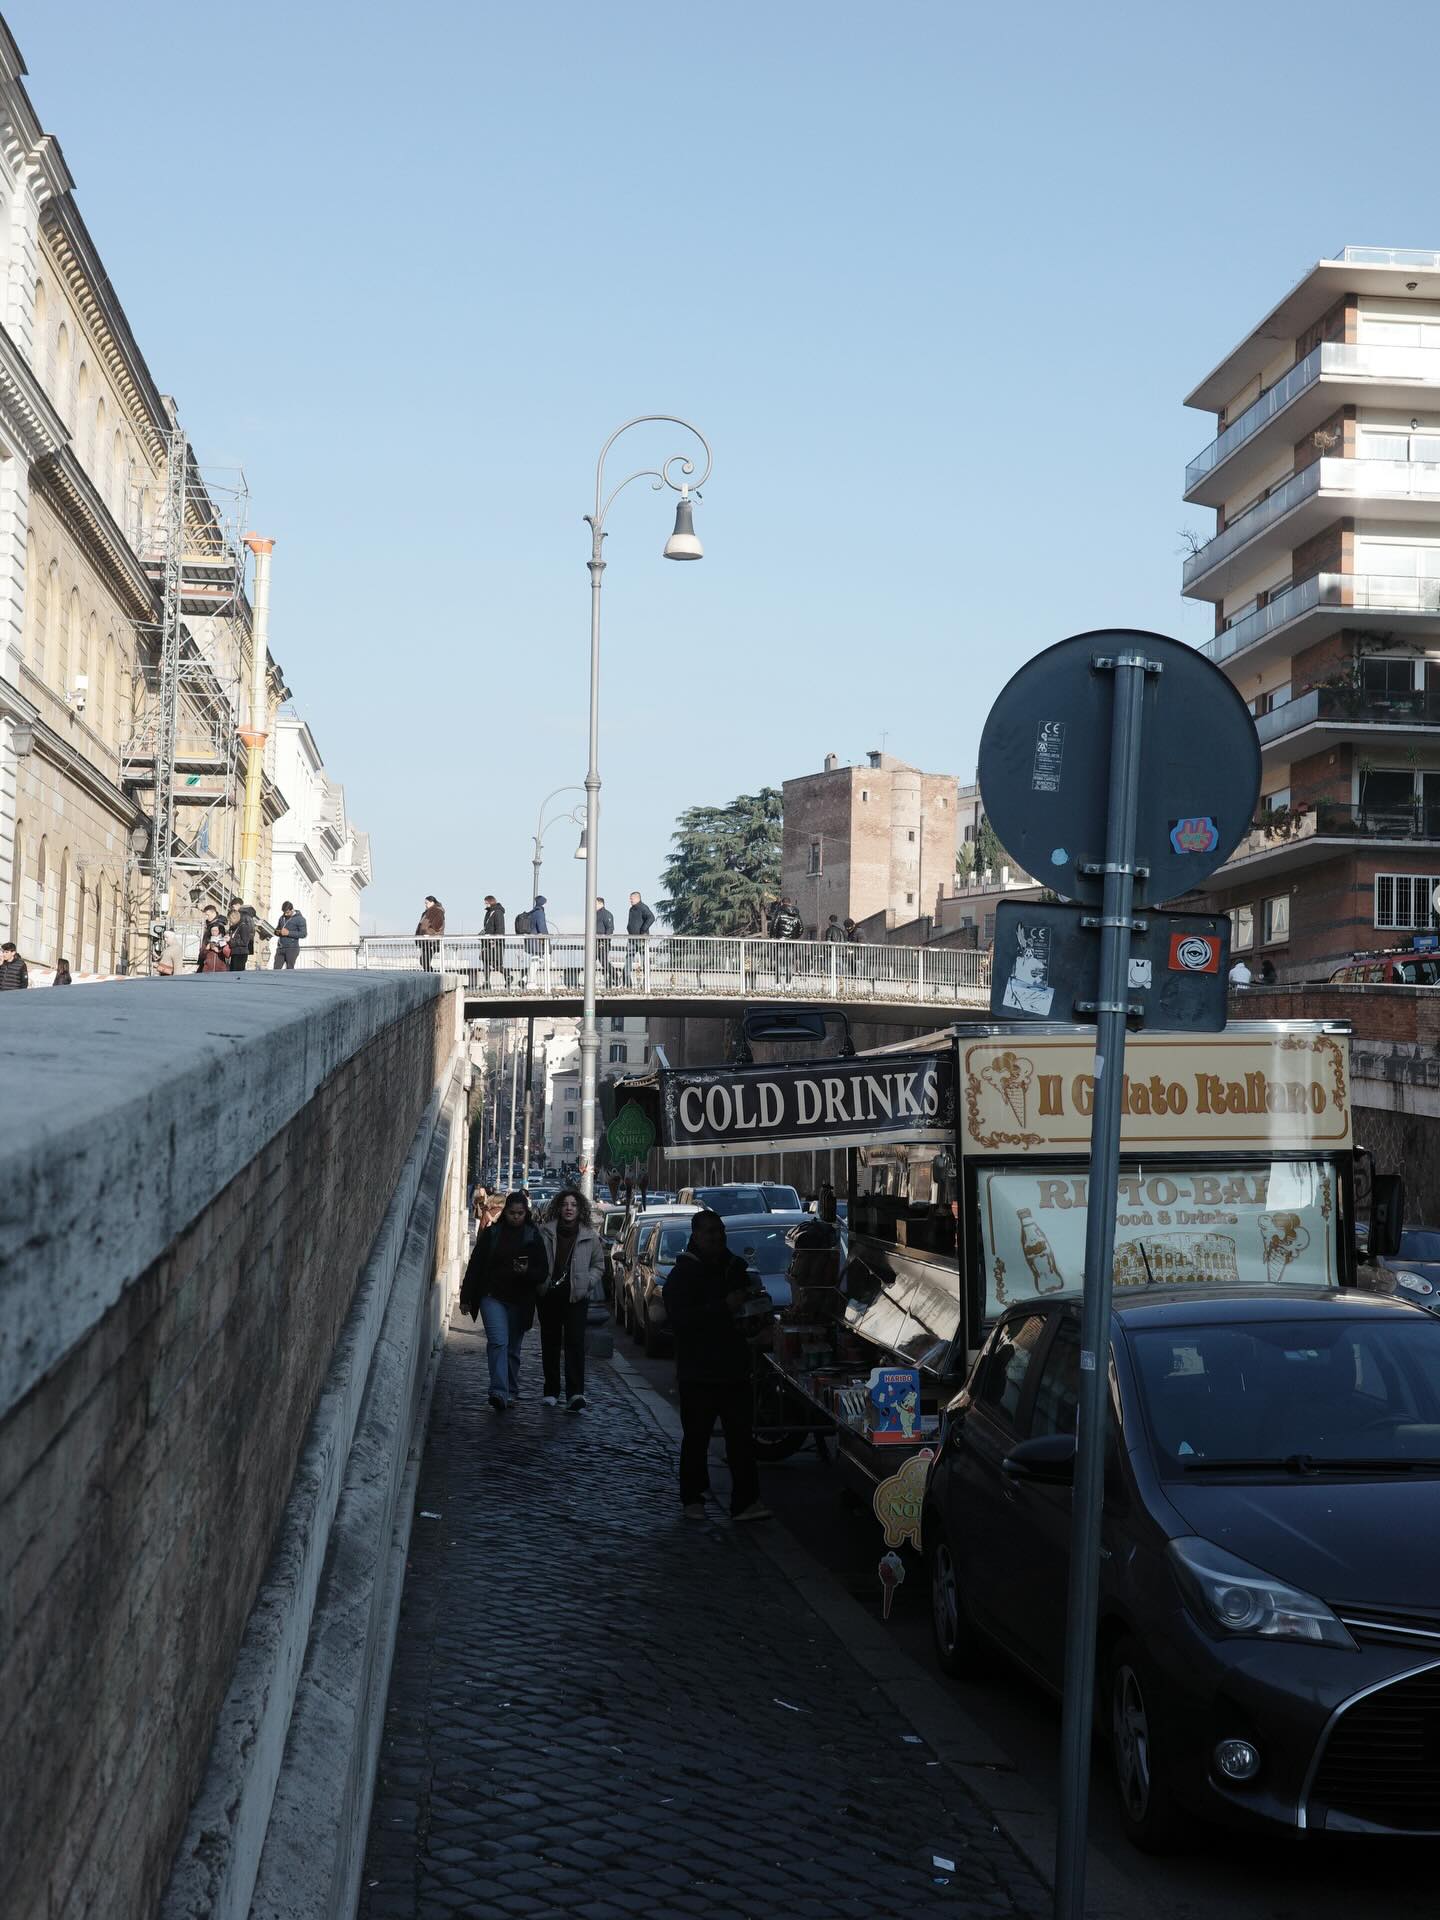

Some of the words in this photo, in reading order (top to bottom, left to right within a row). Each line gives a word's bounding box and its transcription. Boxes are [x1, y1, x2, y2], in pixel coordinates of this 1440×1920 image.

[679, 1083, 785, 1133] COLD
[793, 1070, 939, 1125] DRINKS
[1072, 1073, 1188, 1116] Glato
[1195, 1070, 1327, 1115] Italiano
[1037, 1176, 1270, 1209] RITO-BA
[1116, 1210, 1153, 1226] ood
[884, 1374, 913, 1384] HARIBO
